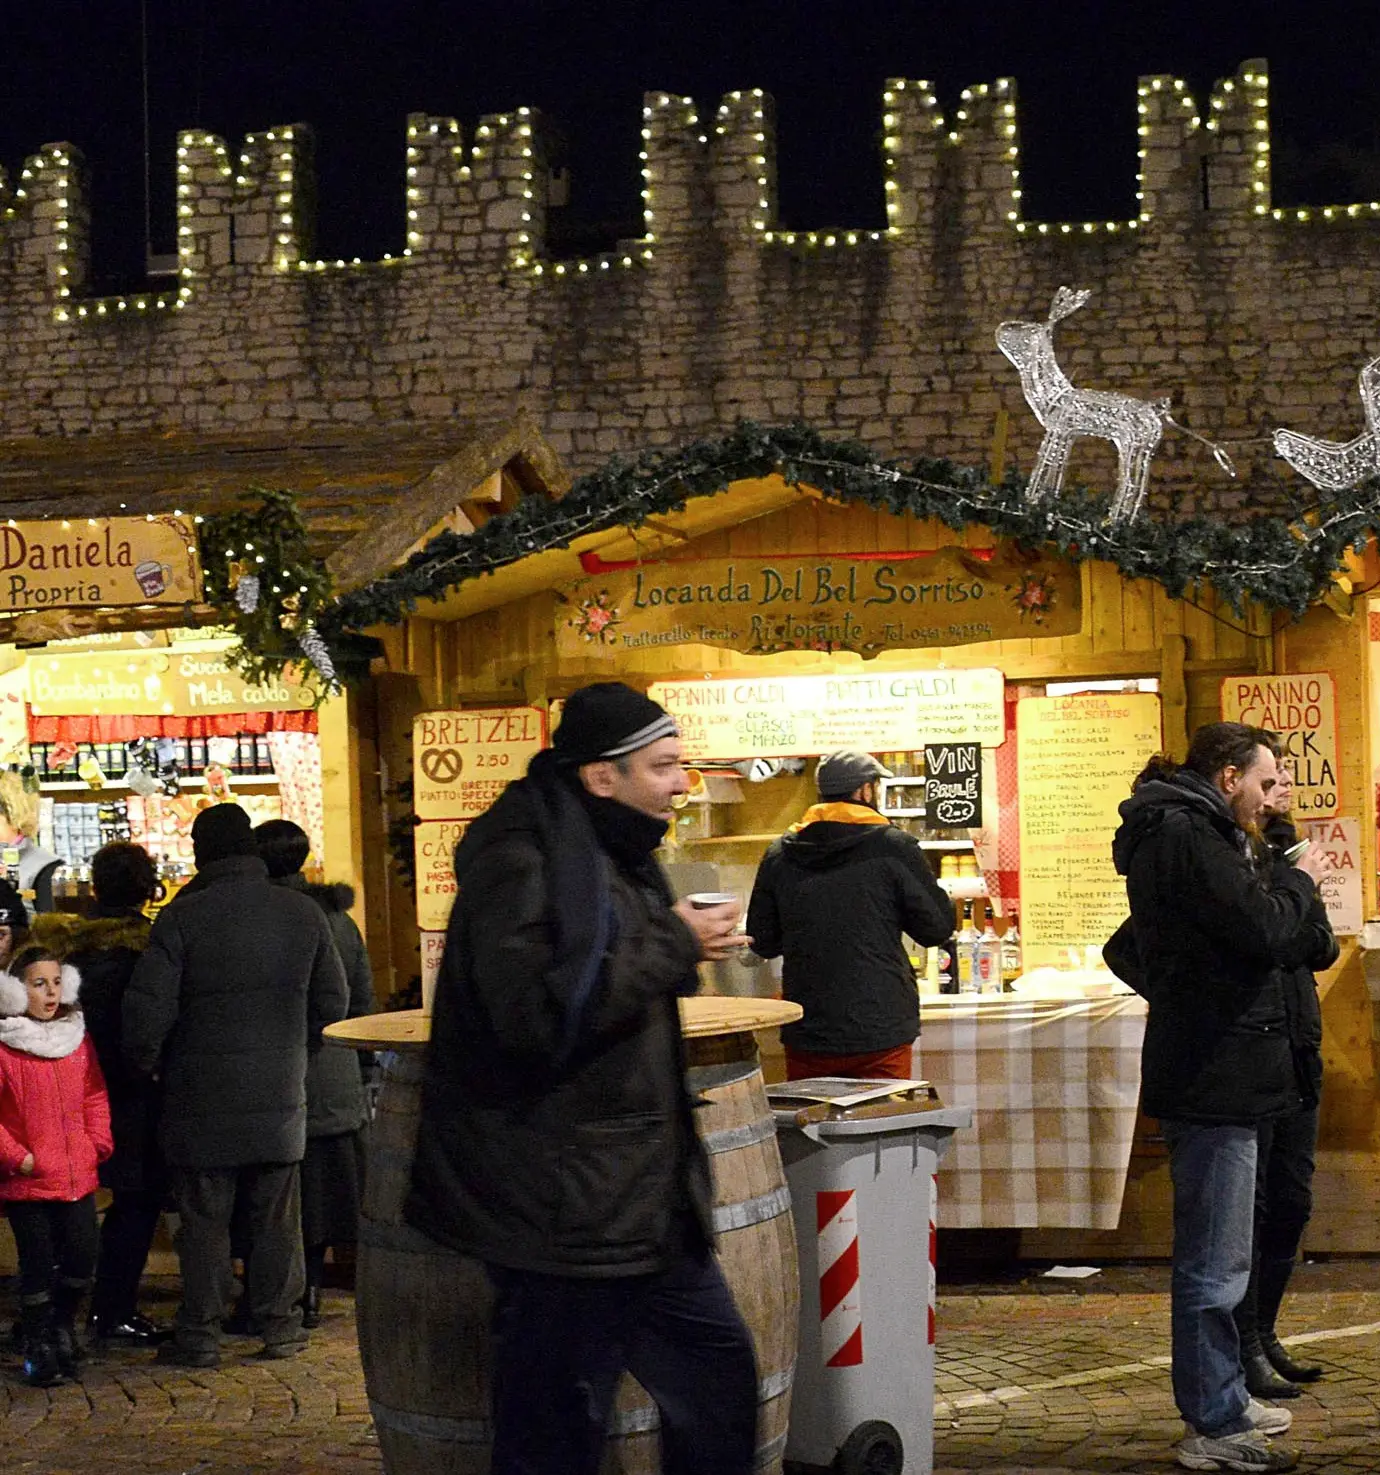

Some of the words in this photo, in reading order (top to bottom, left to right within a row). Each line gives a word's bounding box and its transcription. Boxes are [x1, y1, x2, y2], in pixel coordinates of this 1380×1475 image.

[0, 526, 133, 571] Daniela
[9, 575, 103, 606] Propria
[634, 565, 751, 608] Locanda
[757, 567, 802, 605] Del
[810, 566, 857, 606] Bel
[863, 566, 985, 608] Sorriso
[188, 679, 234, 707] Mela
[242, 669, 290, 704] caldo
[664, 688, 726, 708] PANINI
[733, 685, 784, 704] CALDI
[890, 677, 955, 698] CALDI
[1237, 681, 1321, 706] PANINO
[421, 715, 537, 746] BRETZEL
[1240, 705, 1321, 730] CALDO
[925, 747, 977, 775] VIN
[462, 780, 509, 791] BRETZE
[925, 773, 979, 803] BRULÉ
[1298, 792, 1336, 811] 4.00
